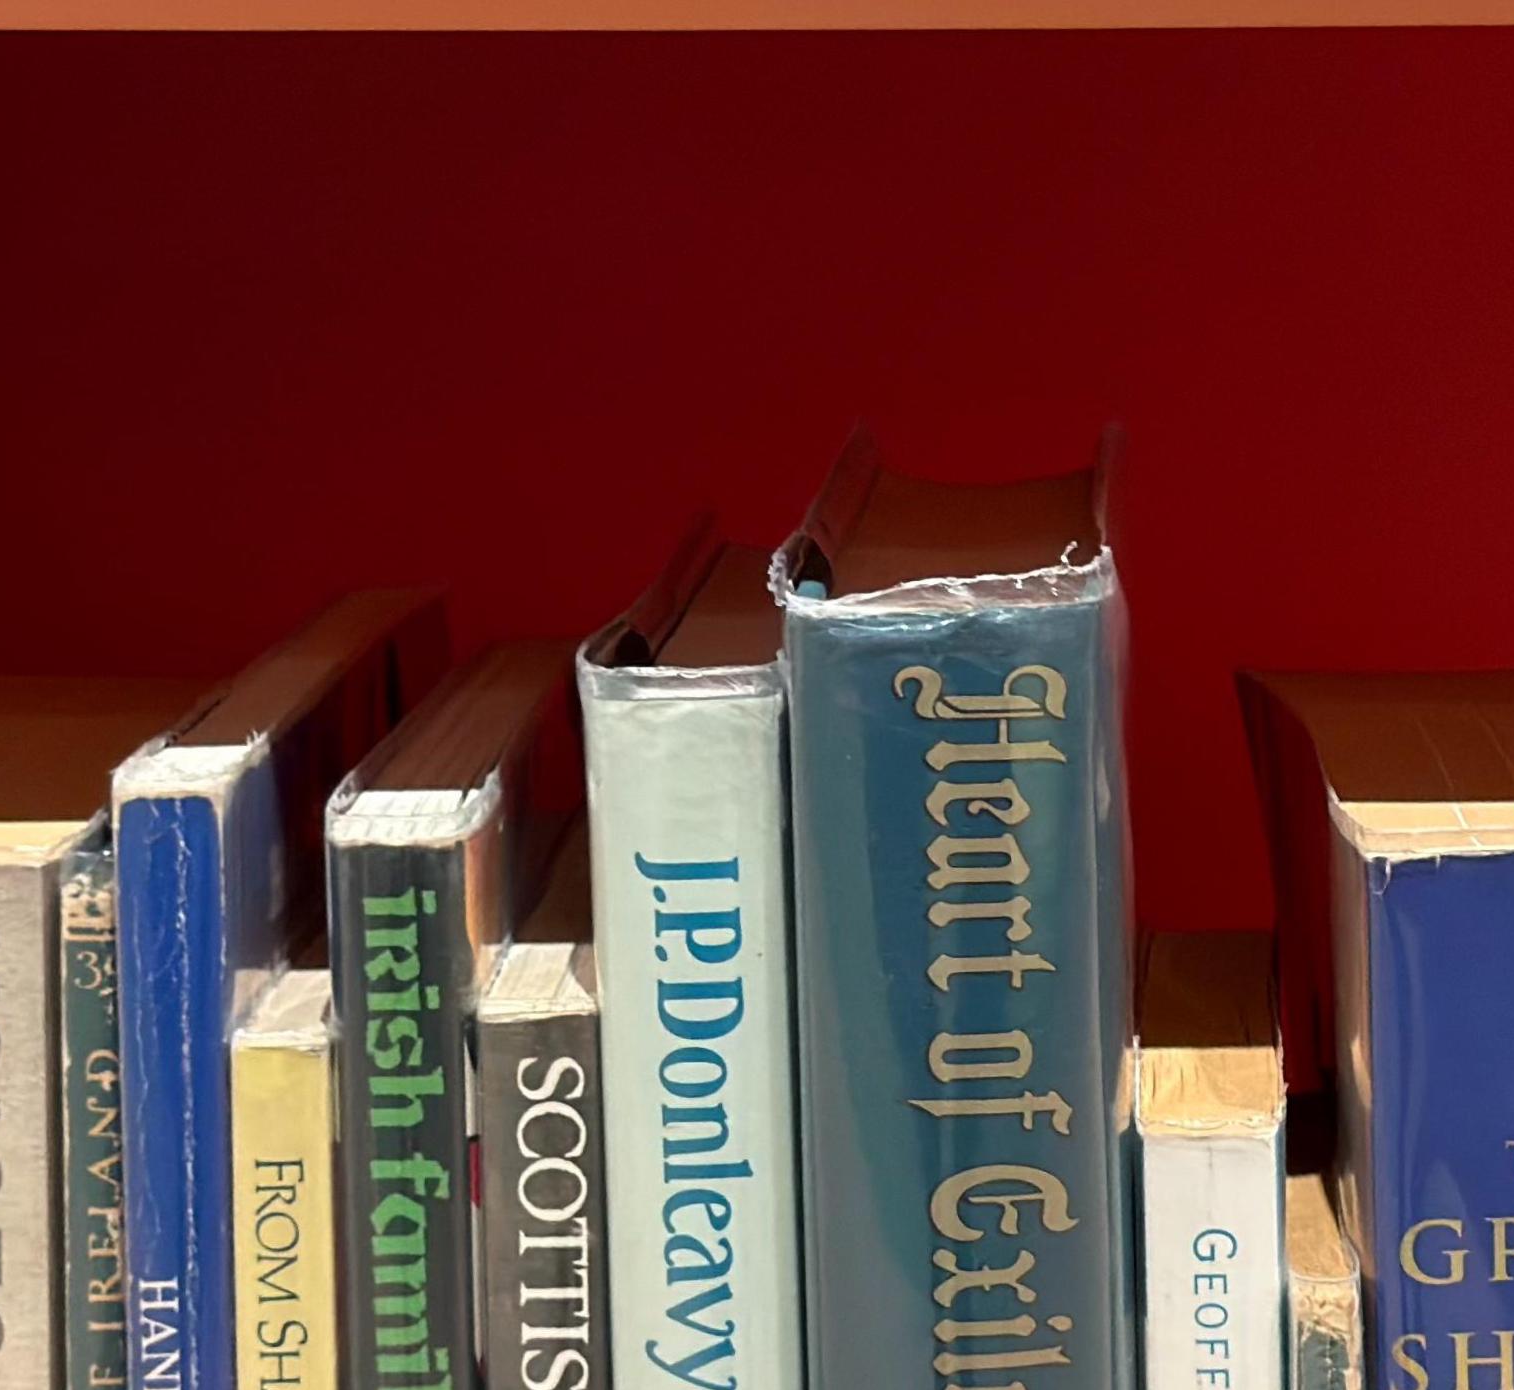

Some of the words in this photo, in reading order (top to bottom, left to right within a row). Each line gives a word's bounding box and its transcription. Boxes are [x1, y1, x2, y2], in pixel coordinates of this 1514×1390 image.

[893, 663, 1070, 993] Heart
[906, 1028, 1075, 1137] of
[85, 1048, 126, 1337] IRELAND
[254, 1157, 304, 1306] FROM
